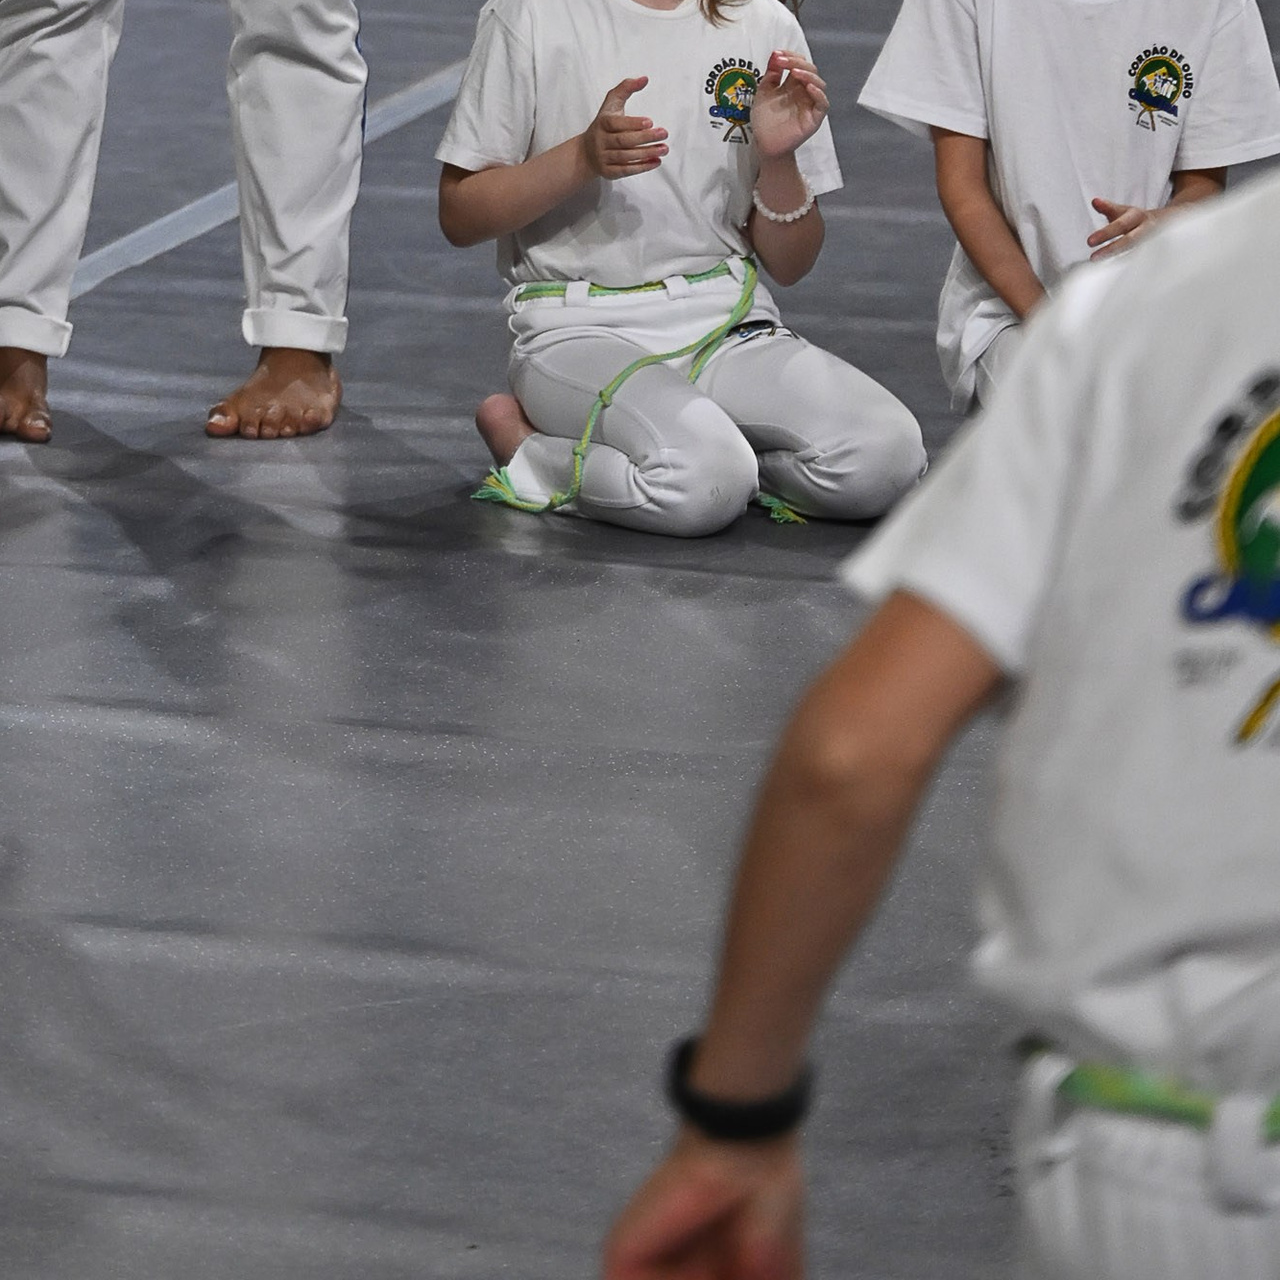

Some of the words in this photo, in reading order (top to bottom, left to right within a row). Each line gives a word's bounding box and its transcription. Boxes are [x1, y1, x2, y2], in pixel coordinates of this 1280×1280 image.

[705, 58, 736, 95] CORDÃO
[738, 58, 753, 71] DE
[1128, 43, 1168, 77] CORDÃO
[1169, 49, 1185, 63] DE
[1182, 63, 1194, 99] OURO
